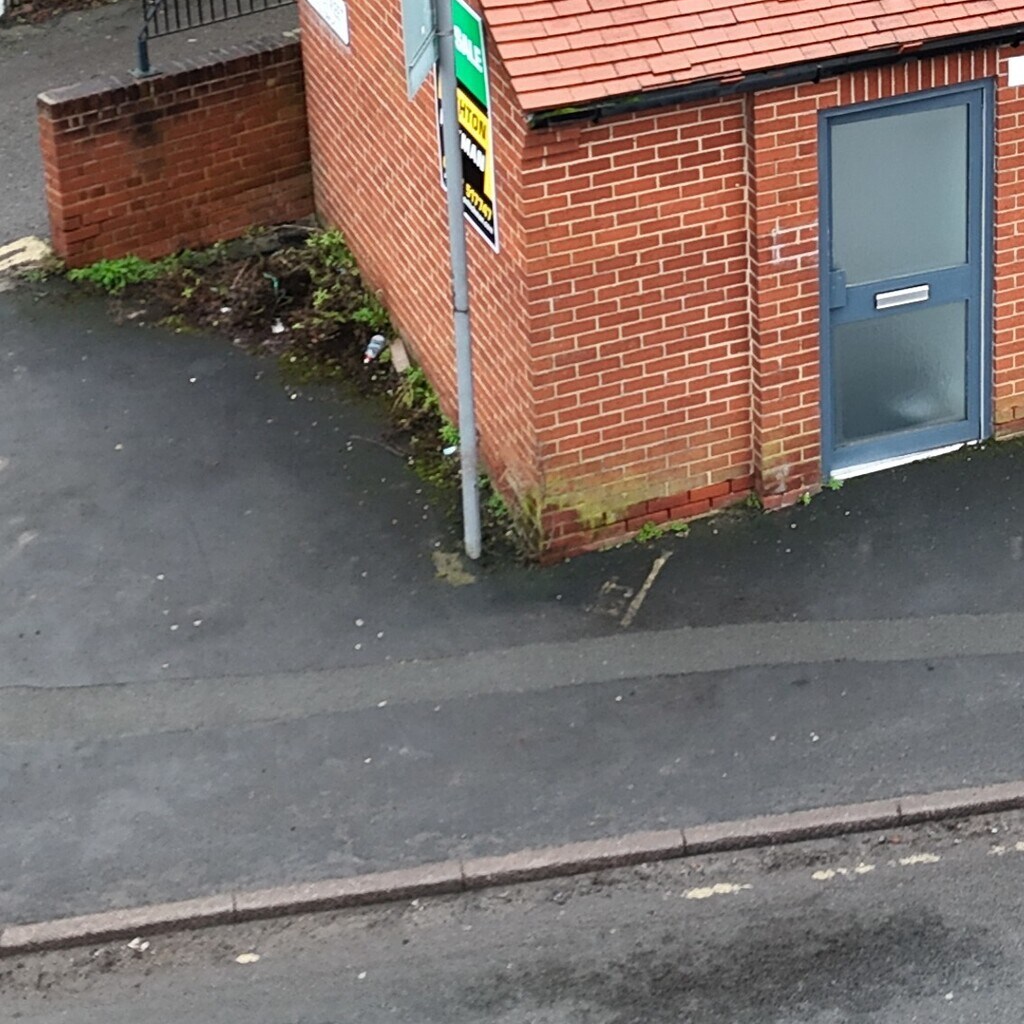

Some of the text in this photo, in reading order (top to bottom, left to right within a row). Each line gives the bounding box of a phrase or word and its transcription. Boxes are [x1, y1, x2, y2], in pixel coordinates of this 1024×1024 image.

[453, 24, 484, 74] SALE
[458, 98, 487, 140] HTON
[458, 129, 486, 172] MAN
